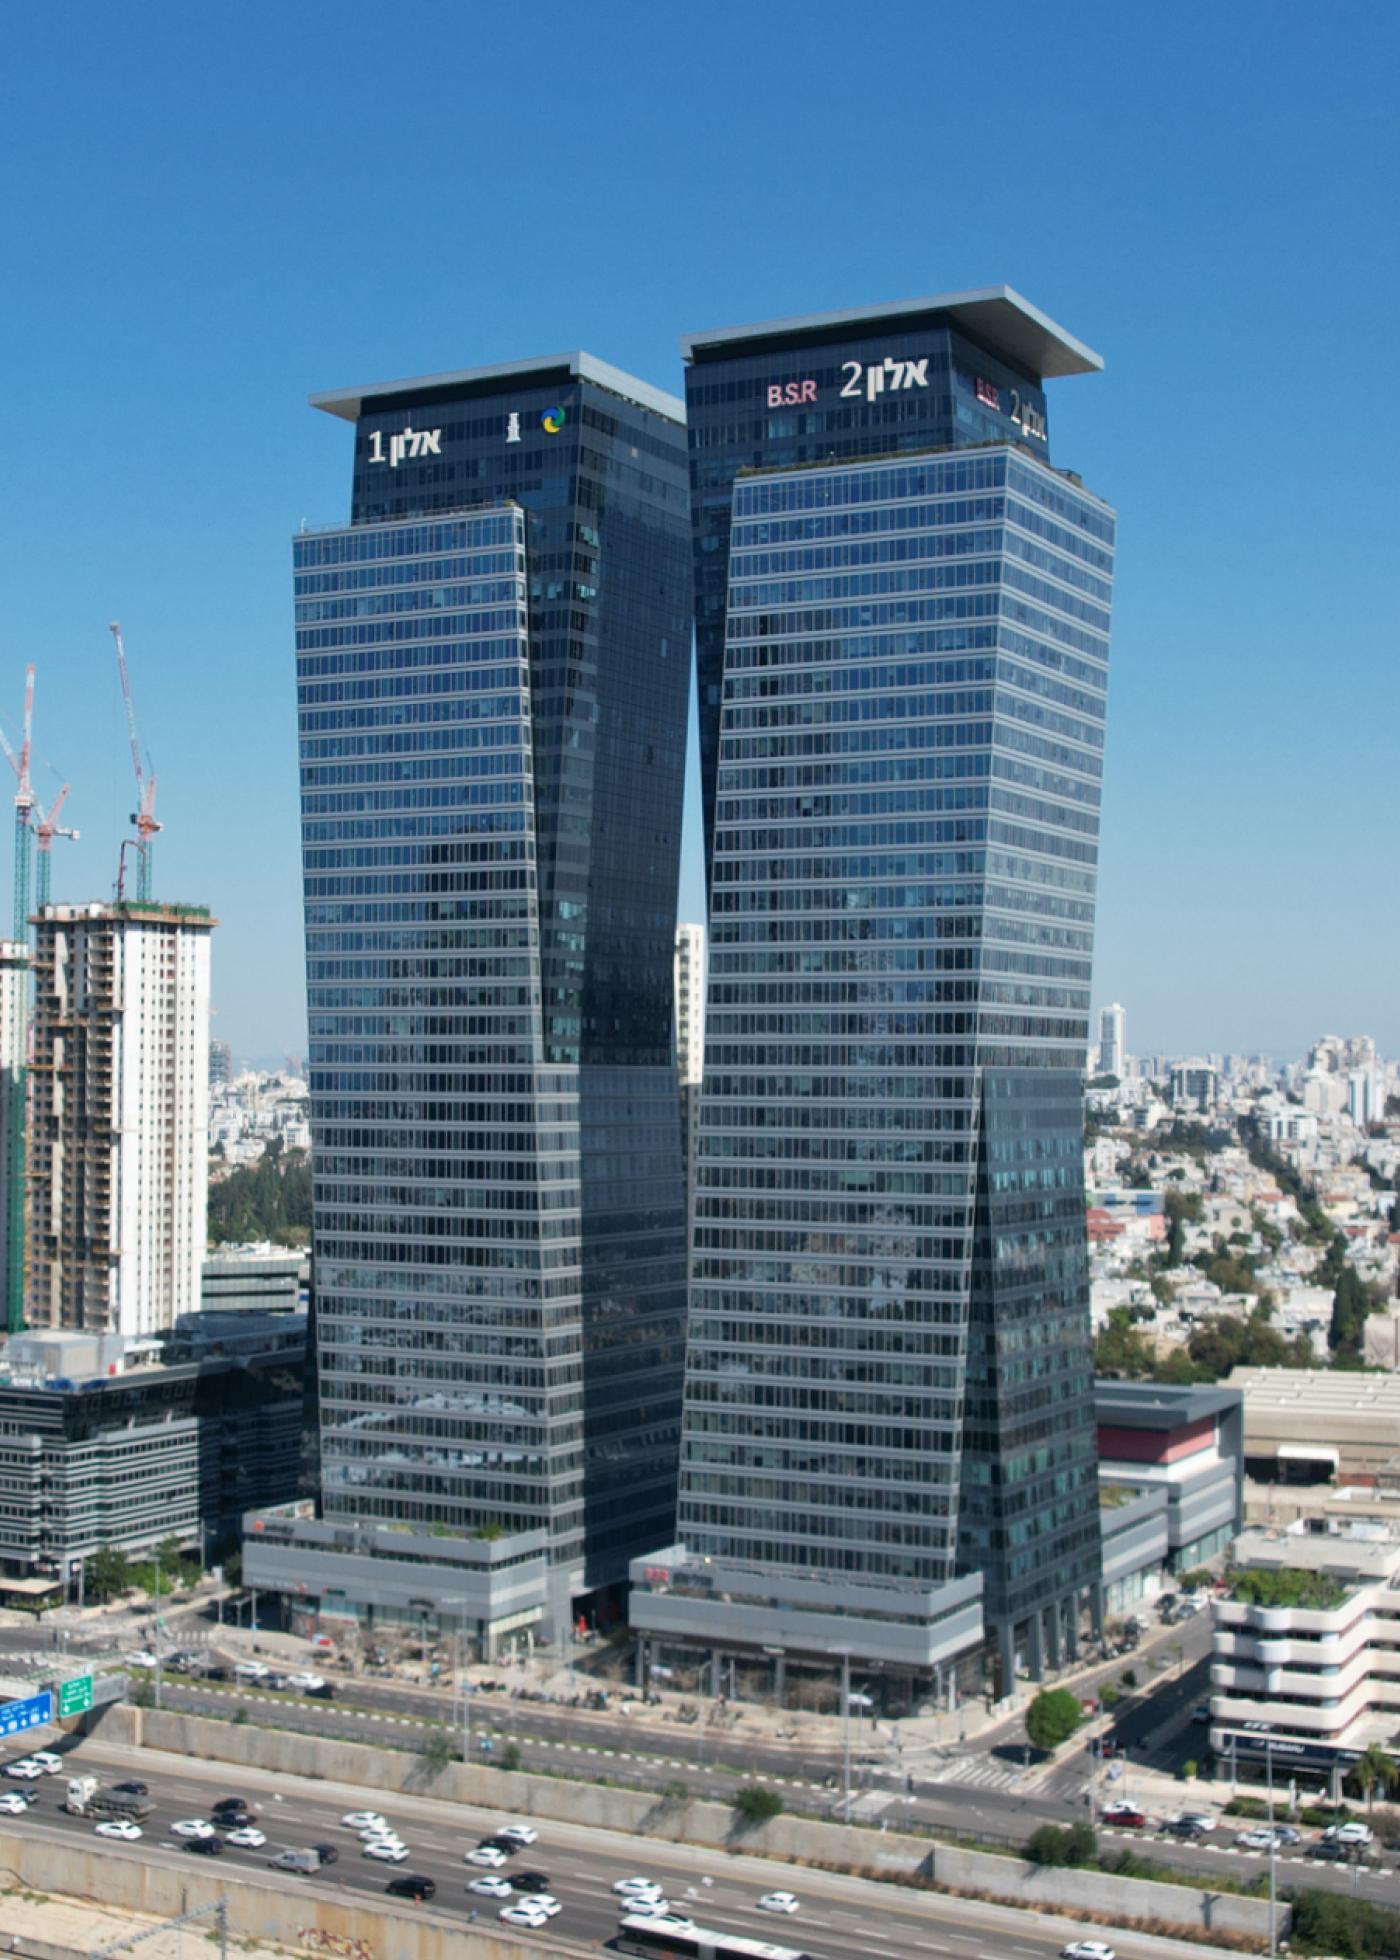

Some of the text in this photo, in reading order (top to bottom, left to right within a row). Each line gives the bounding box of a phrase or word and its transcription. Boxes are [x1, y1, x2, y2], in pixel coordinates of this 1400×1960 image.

[839, 357, 929, 402] אלון 2
[368, 427, 441, 467] אלון 1
